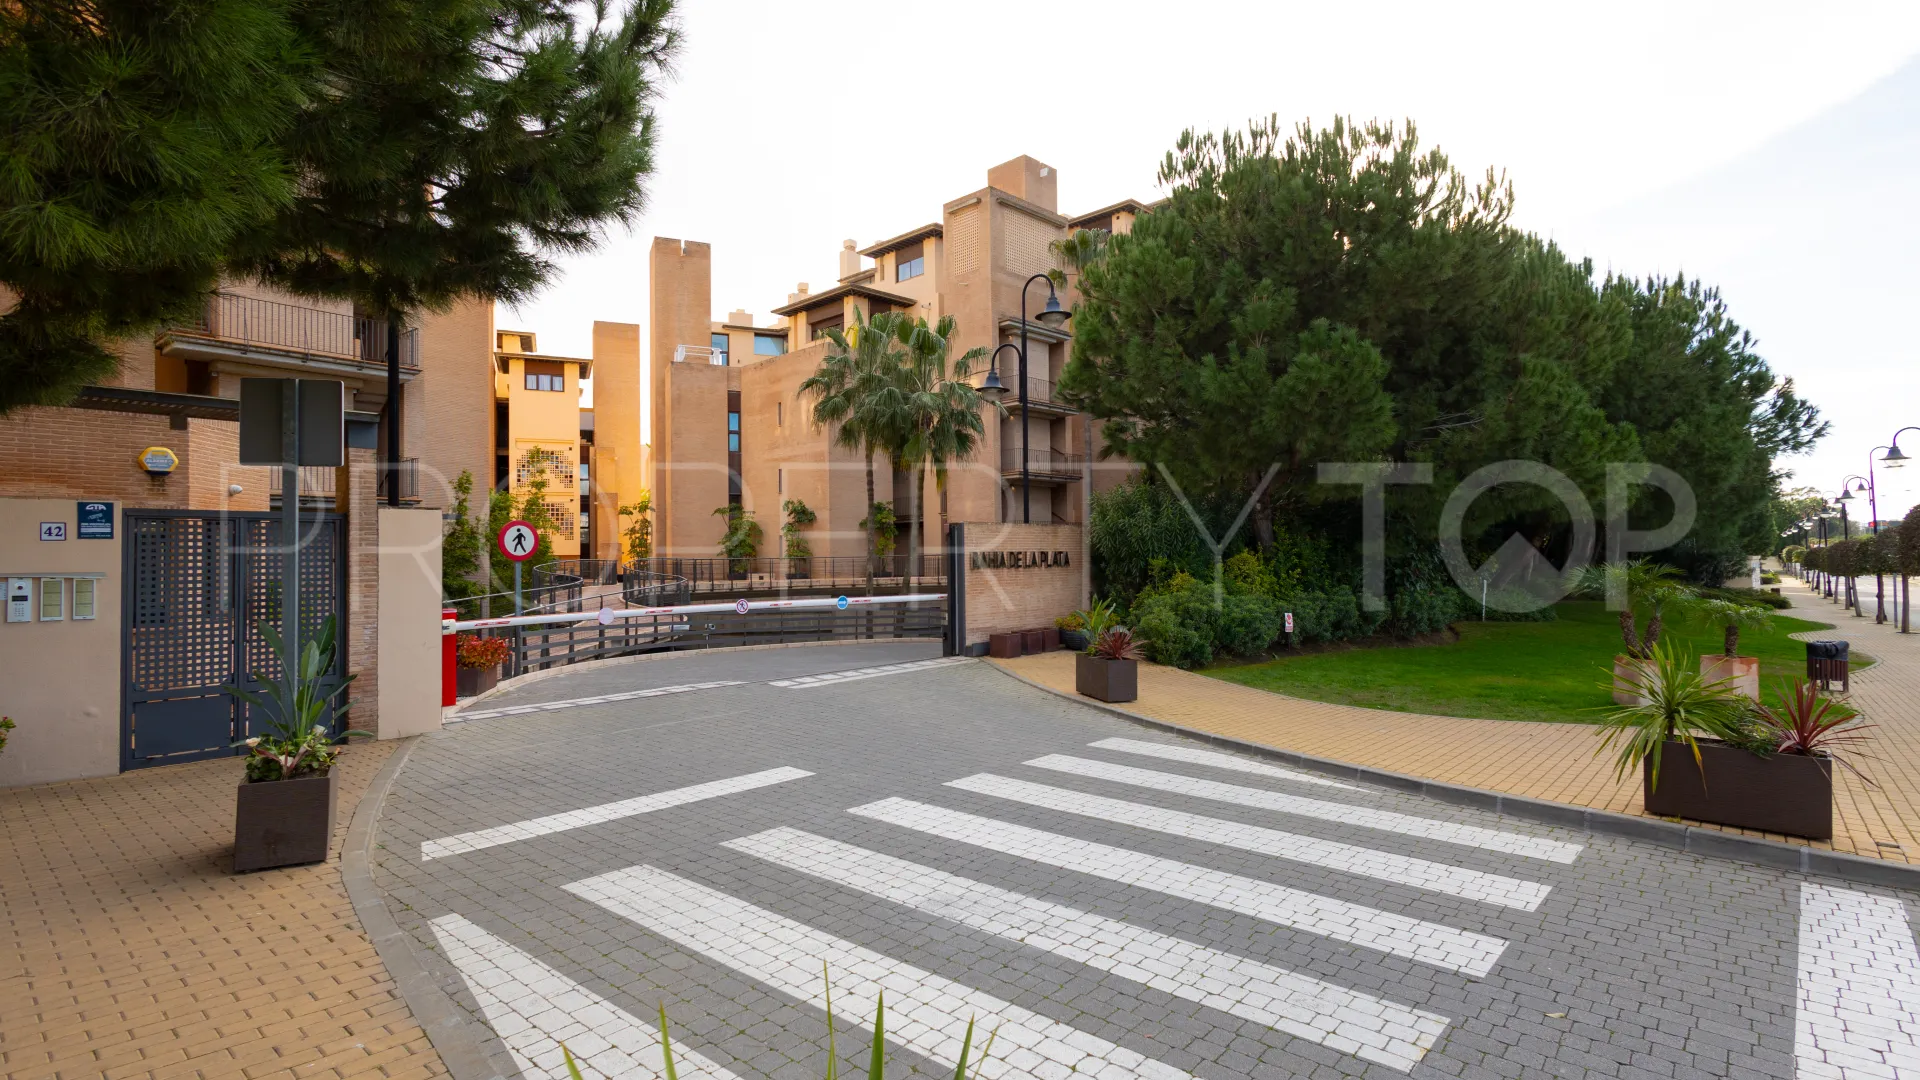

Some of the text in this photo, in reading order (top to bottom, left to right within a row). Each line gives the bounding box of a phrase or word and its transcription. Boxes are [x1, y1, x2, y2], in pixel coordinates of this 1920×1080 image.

[44, 526, 63, 537] 42
[1008, 551, 1022, 568] DE
[1024, 551, 1038, 568] LA
[1040, 551, 1070, 567] PLATA
